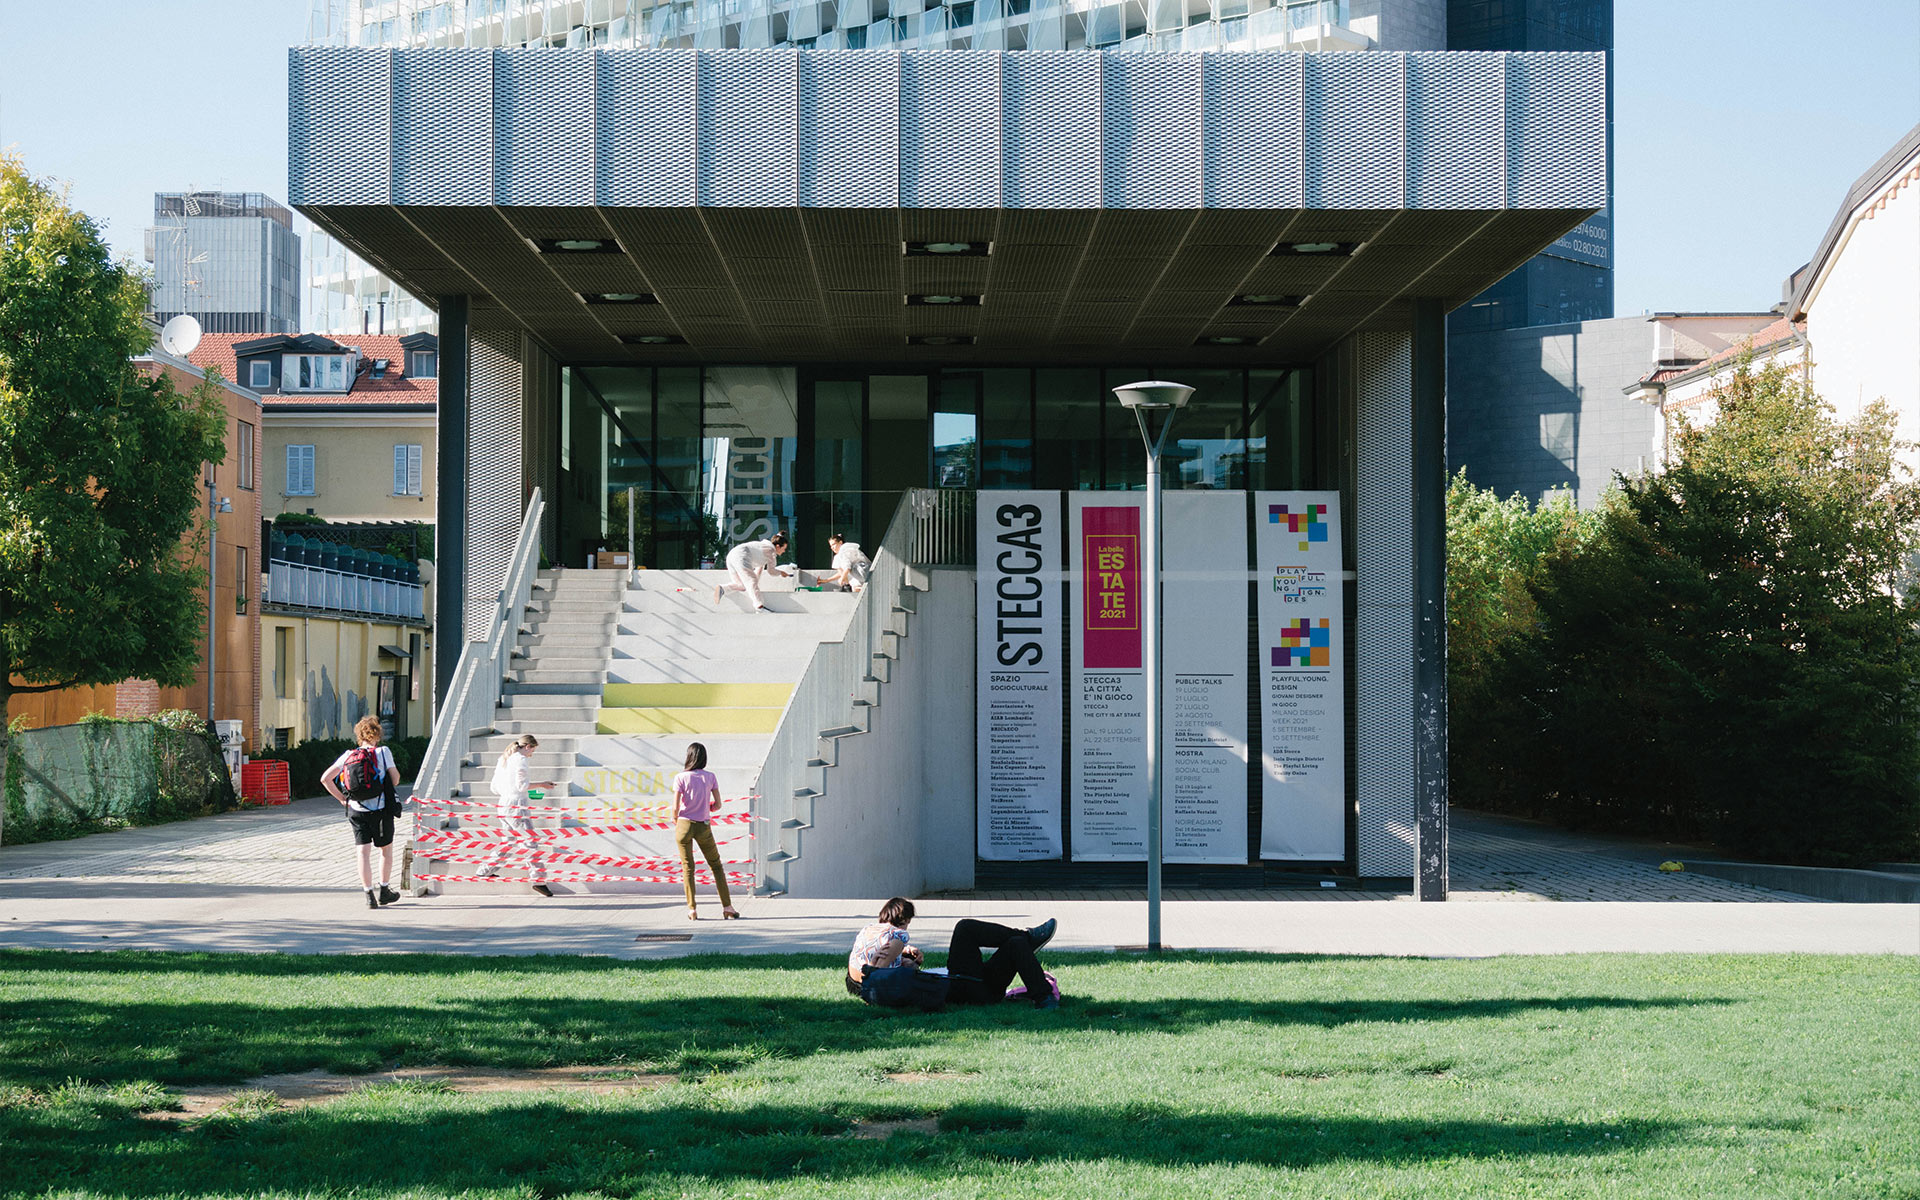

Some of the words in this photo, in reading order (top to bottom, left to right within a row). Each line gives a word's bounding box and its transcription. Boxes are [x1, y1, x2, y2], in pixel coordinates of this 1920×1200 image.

[1099, 553, 1125, 570] ES
[996, 504, 1043, 666] STECCA3
[1099, 572, 1125, 589] TA
[1099, 592, 1126, 608] TE
[1100, 610, 1126, 618] 2021
